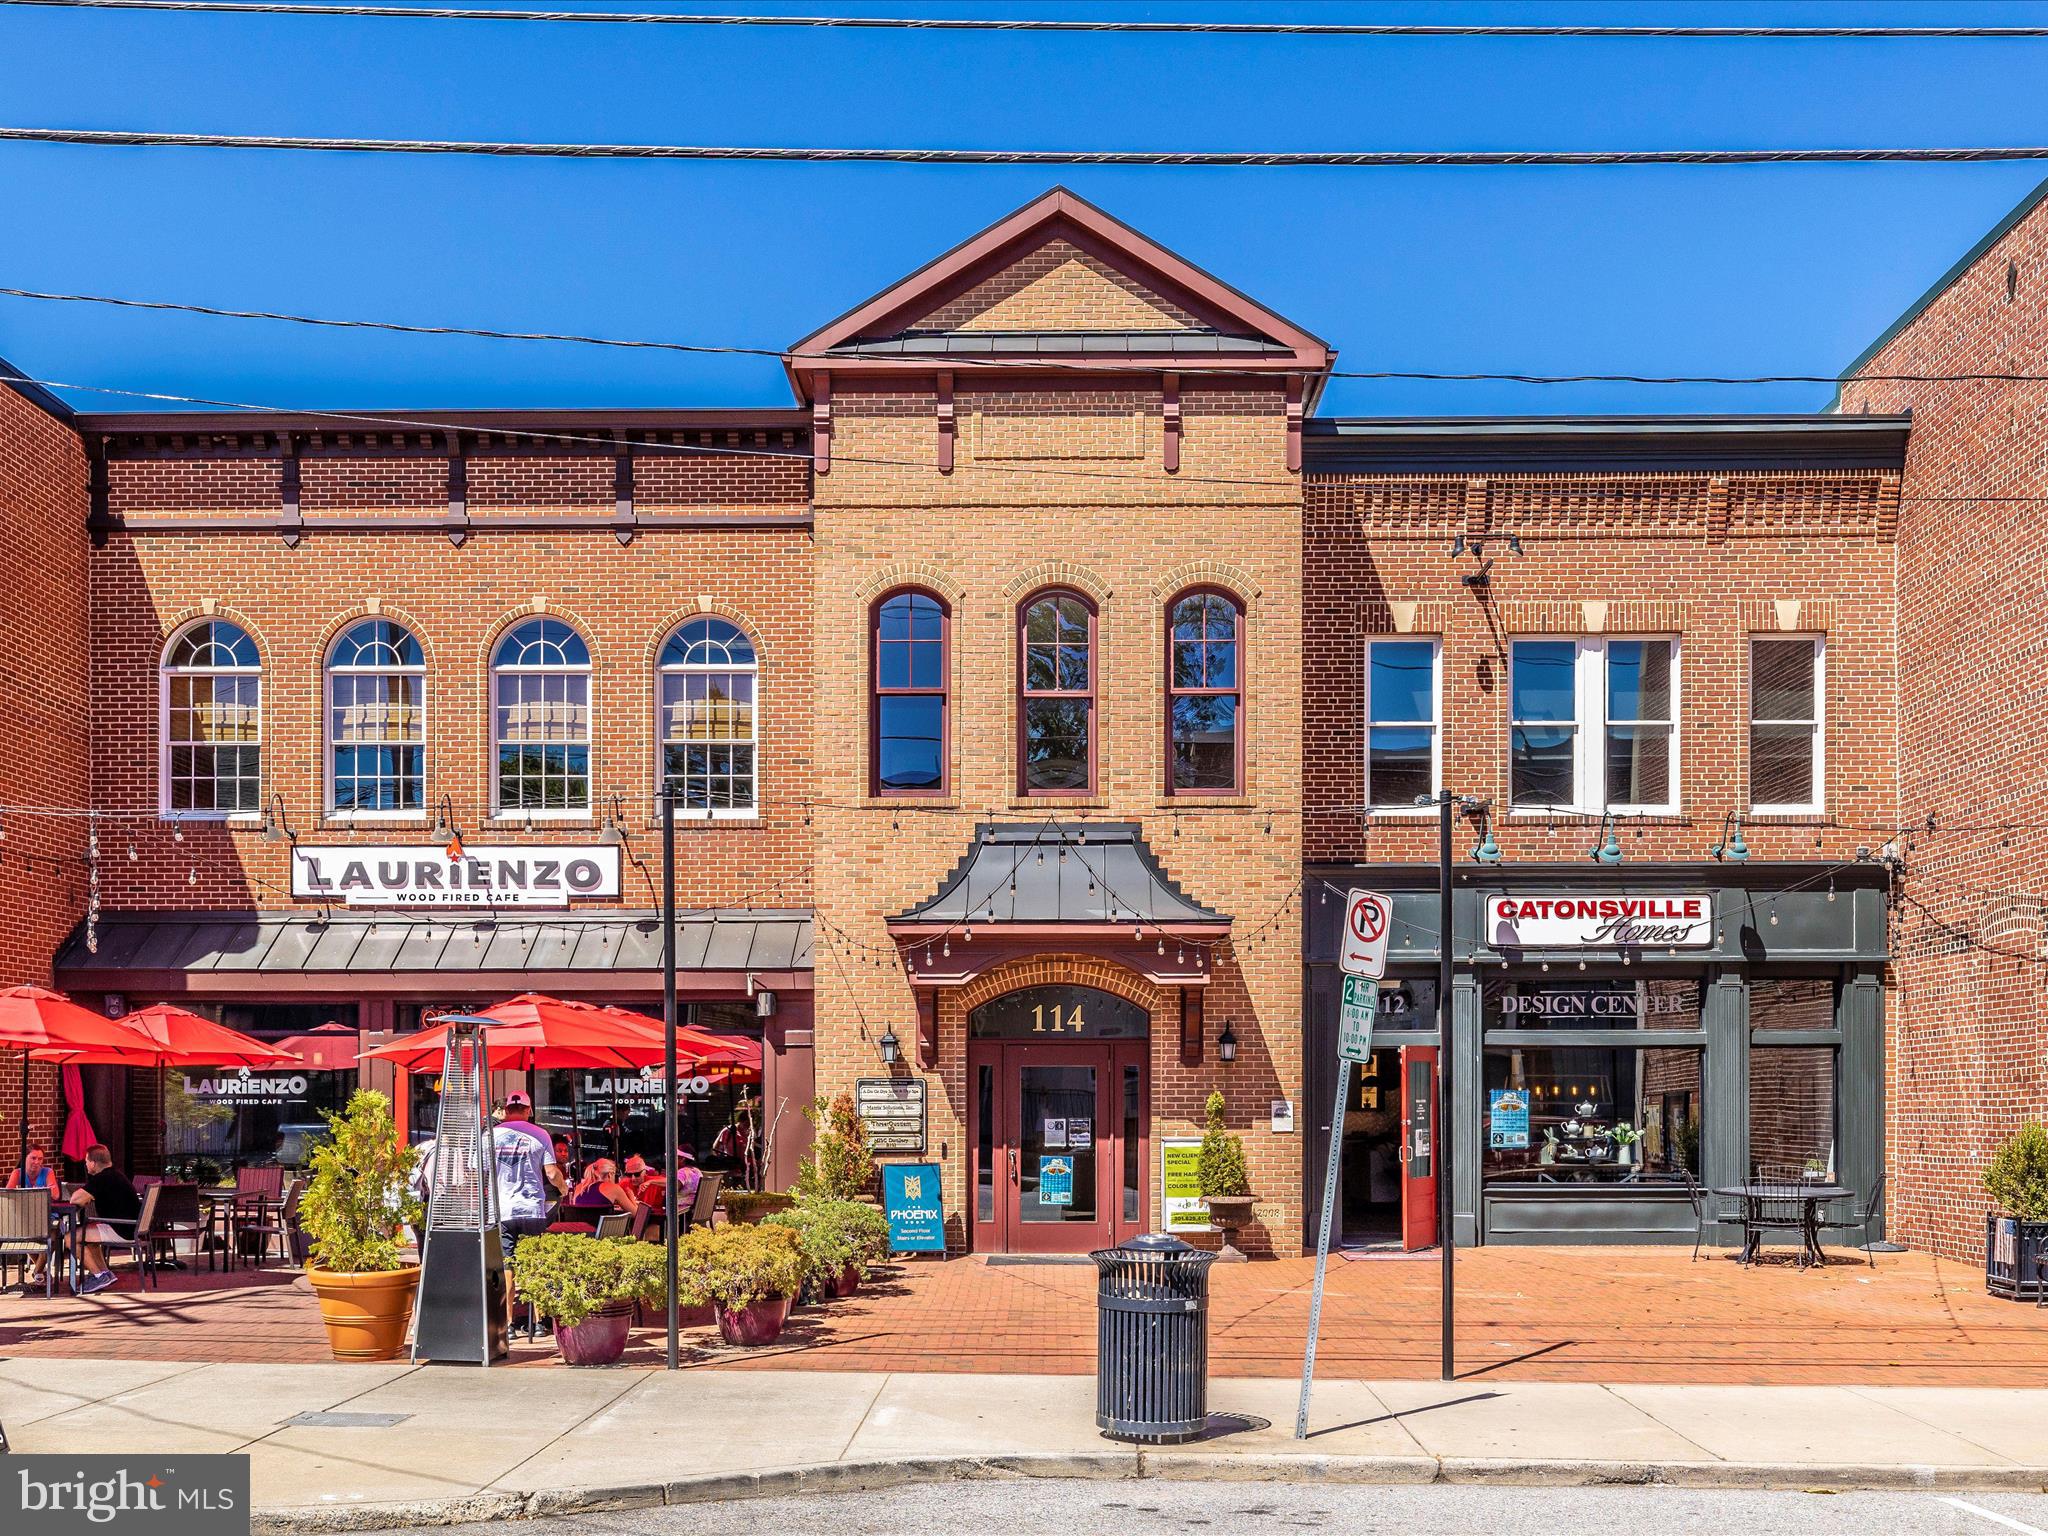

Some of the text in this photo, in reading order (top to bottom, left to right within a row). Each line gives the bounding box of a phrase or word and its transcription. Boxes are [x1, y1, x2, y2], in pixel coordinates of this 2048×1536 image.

[307, 857, 602, 891] LAURIENZO
[396, 893, 520, 902] WOOD FIRED CAFE
[1497, 900, 1702, 919] CATONSVILLE
[1580, 914, 1695, 942] Homes
[1345, 980, 1354, 1001] 2
[1353, 993, 1375, 1006] PARKING
[1501, 995, 1684, 1014] DESIGN CENTER
[1031, 1004, 1085, 1032] 114
[1361, 1010, 1369, 1020] AM
[1353, 1021, 1360, 1032] TO
[1358, 1035, 1367, 1046] PM
[585, 1076, 709, 1095] LAURIEZO
[890, 1209, 938, 1220] PHOENIX
[1257, 1208, 1280, 1218] 2008
